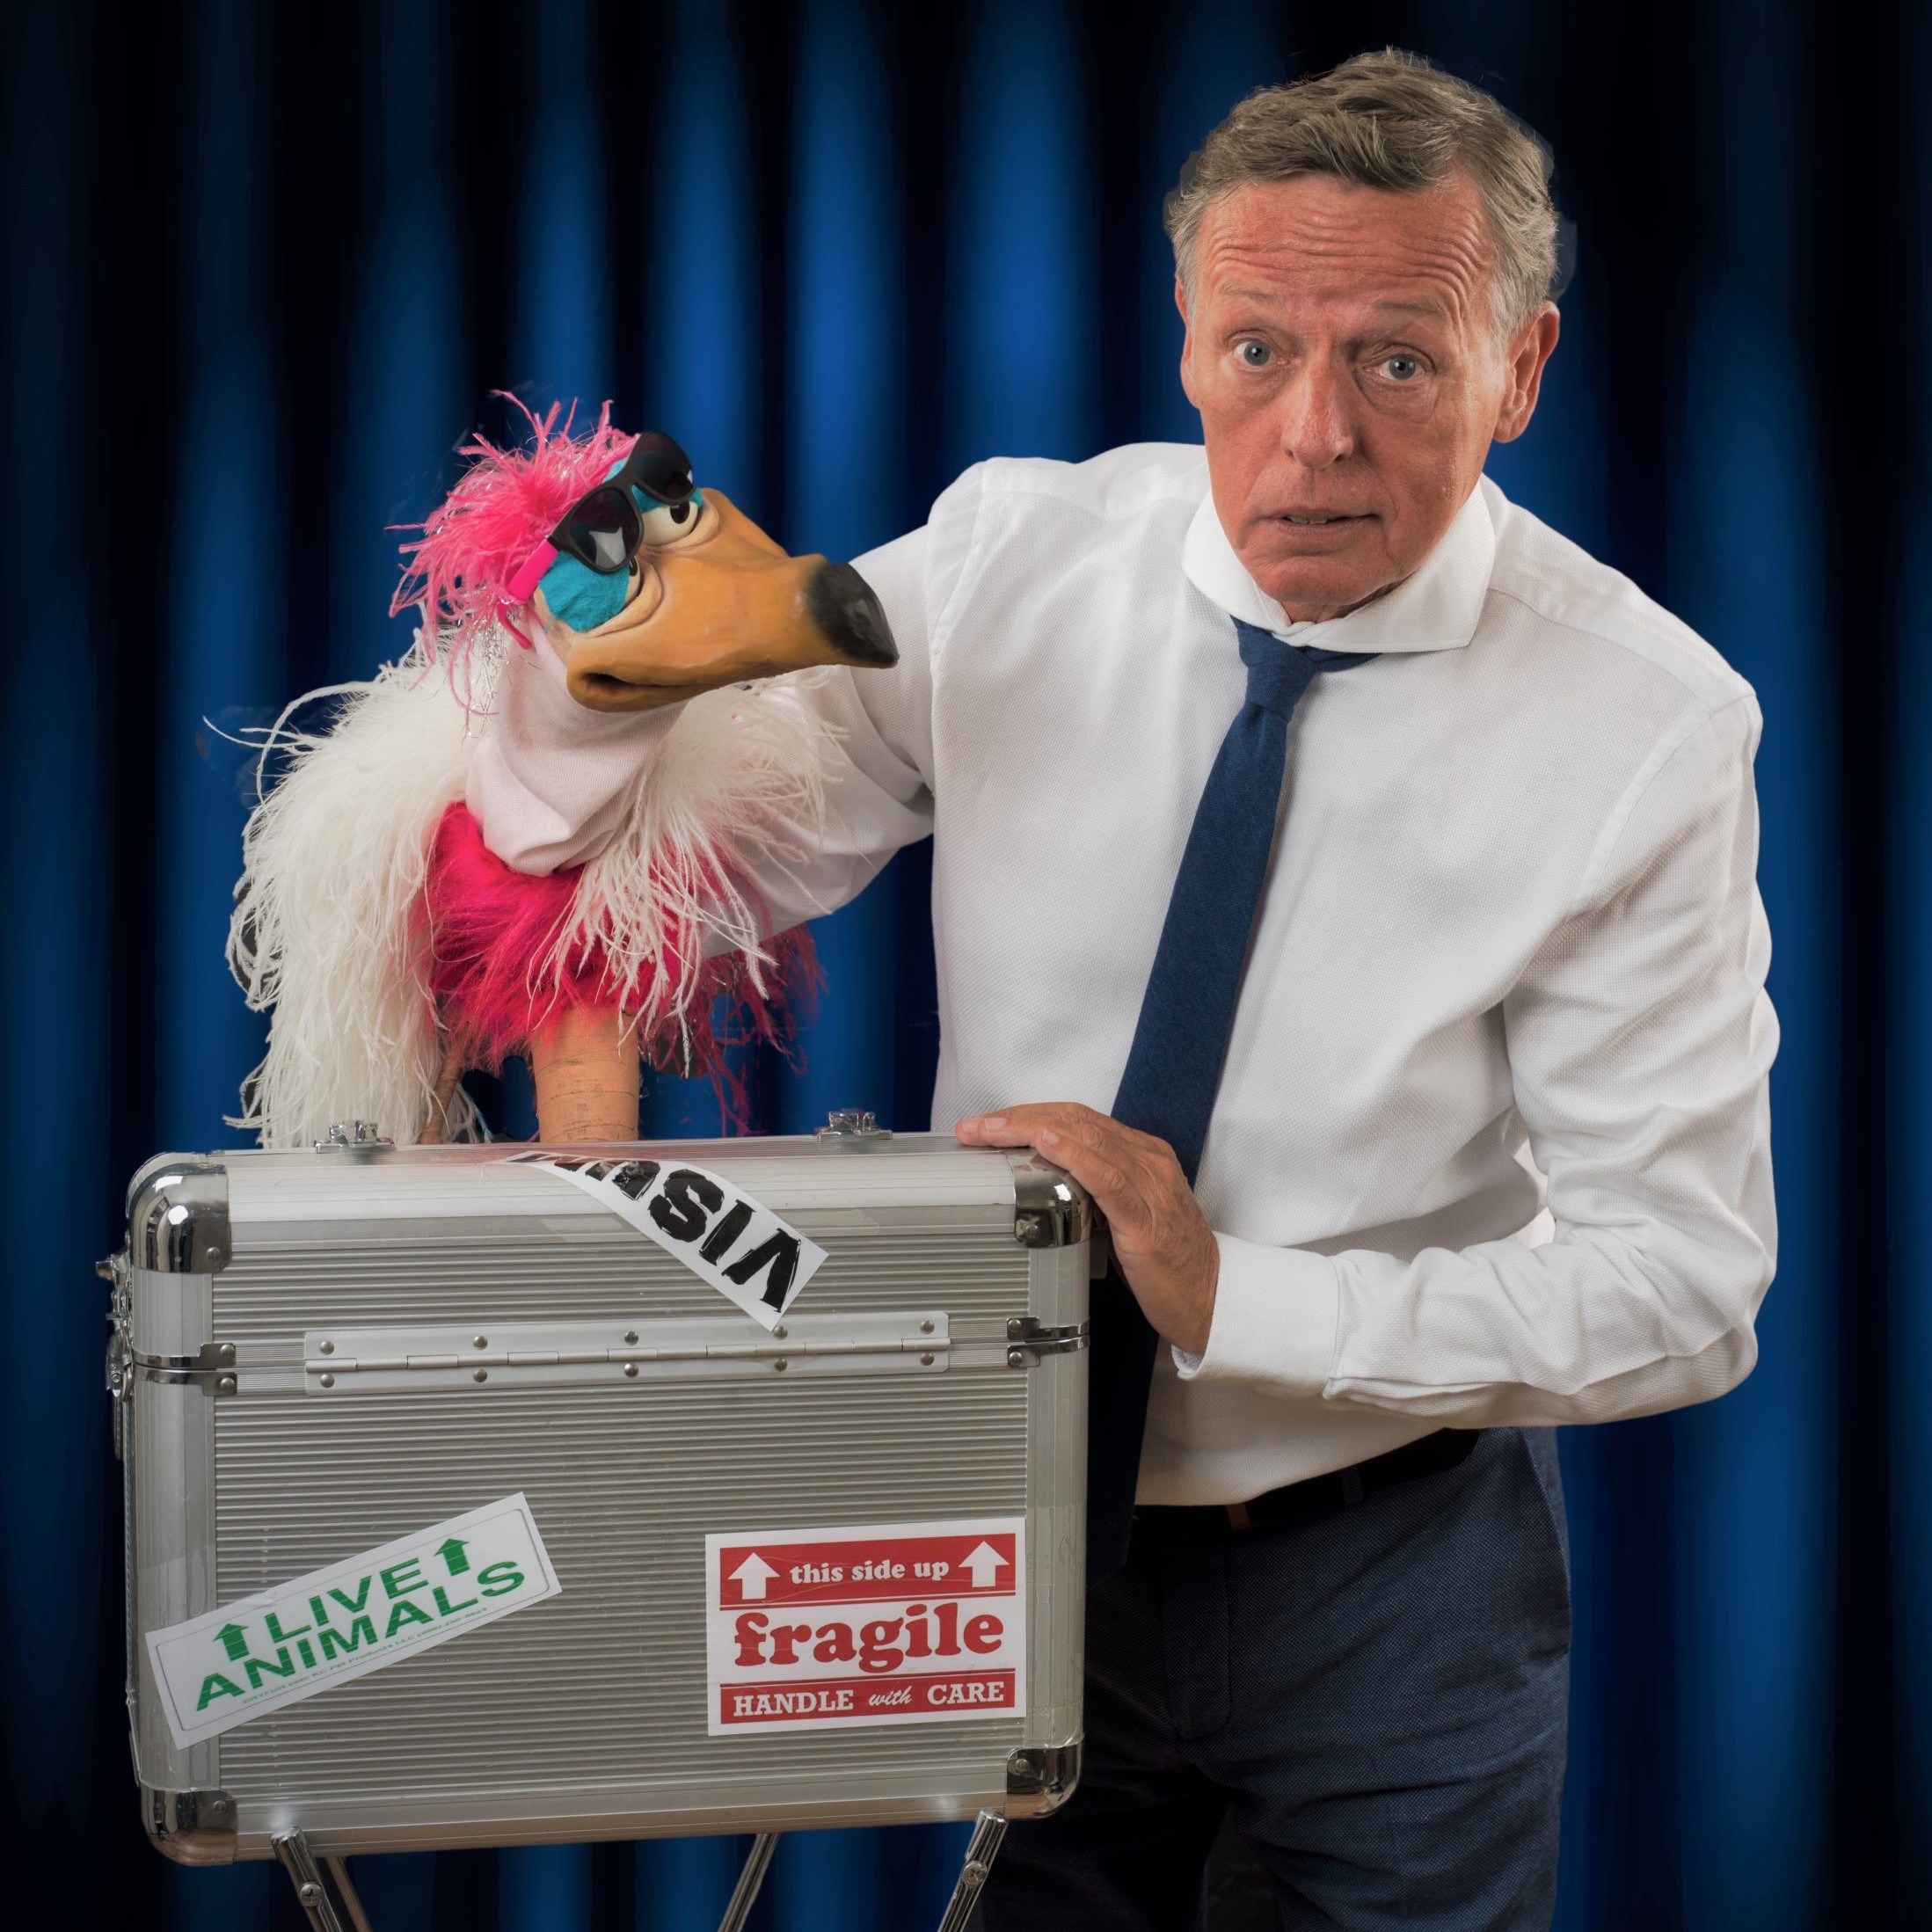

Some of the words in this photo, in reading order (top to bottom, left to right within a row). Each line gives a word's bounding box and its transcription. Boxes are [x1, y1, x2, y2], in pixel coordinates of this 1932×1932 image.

[264, 1557, 429, 1644] LIVE
[789, 1563, 844, 1585] this
[850, 1558, 906, 1581] side
[912, 1560, 951, 1581] up
[195, 1561, 526, 1712] ANIMALS
[733, 1601, 1005, 1673] fragile
[733, 1688, 855, 1717] HANDLE
[867, 1685, 913, 1707] with
[926, 1680, 1005, 1706] CARE
